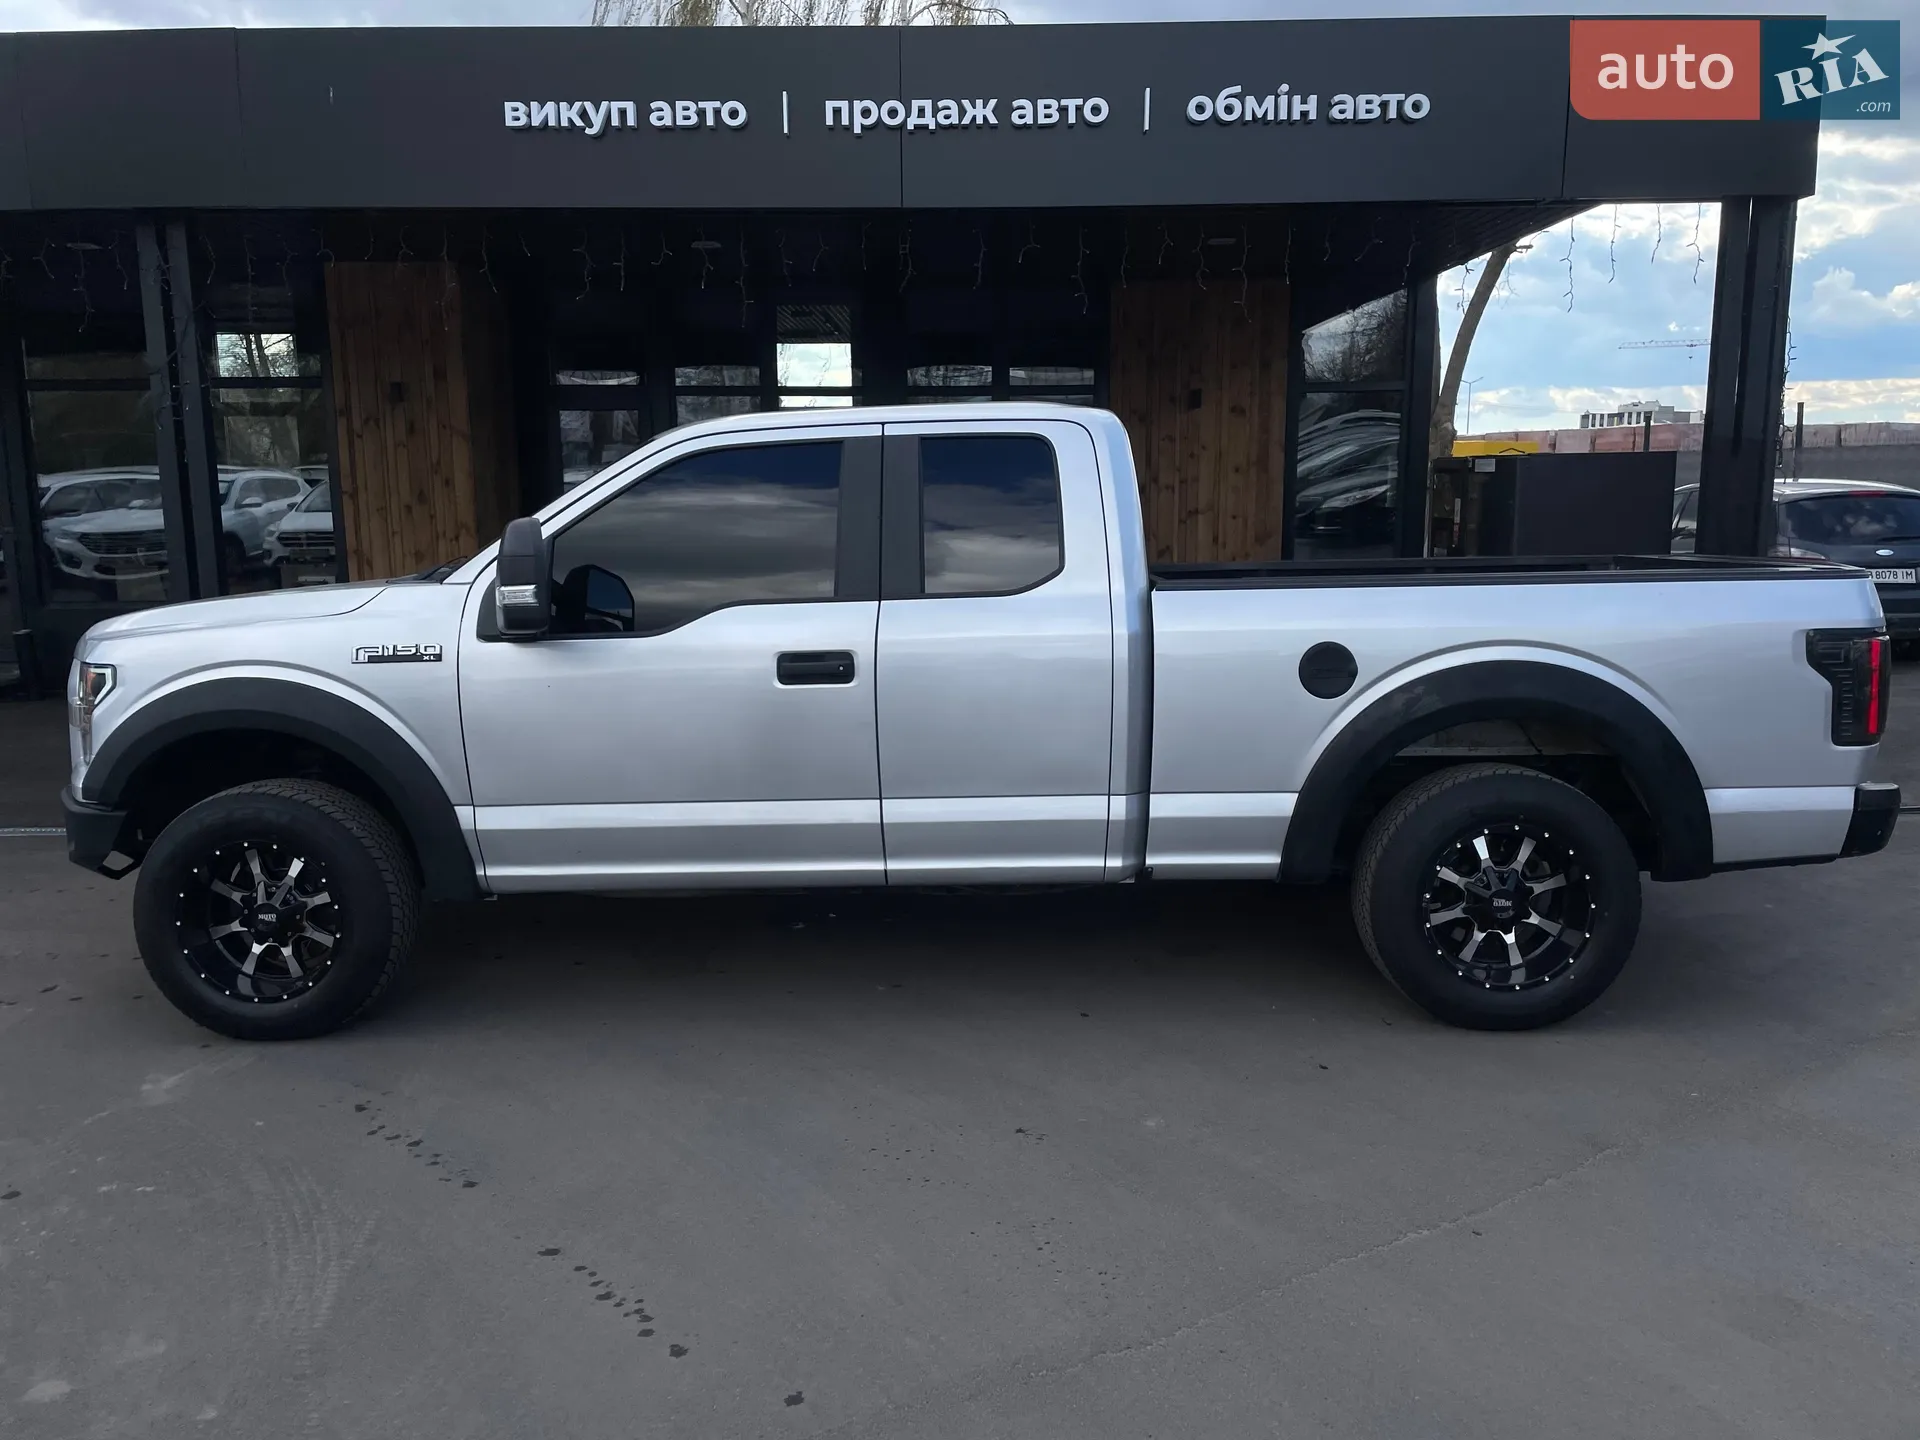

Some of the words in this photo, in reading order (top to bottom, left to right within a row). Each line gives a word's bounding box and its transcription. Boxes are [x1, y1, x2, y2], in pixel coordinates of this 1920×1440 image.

[503, 101, 638, 137] викуп
[649, 100, 748, 128] авто
[825, 98, 999, 135] продаж
[1010, 97, 1110, 126] авто
[1187, 83, 1318, 122] обмін
[1330, 93, 1431, 121] авто
[1875, 570, 1898, 580] 8078
[1901, 570, 1913, 580] IM
